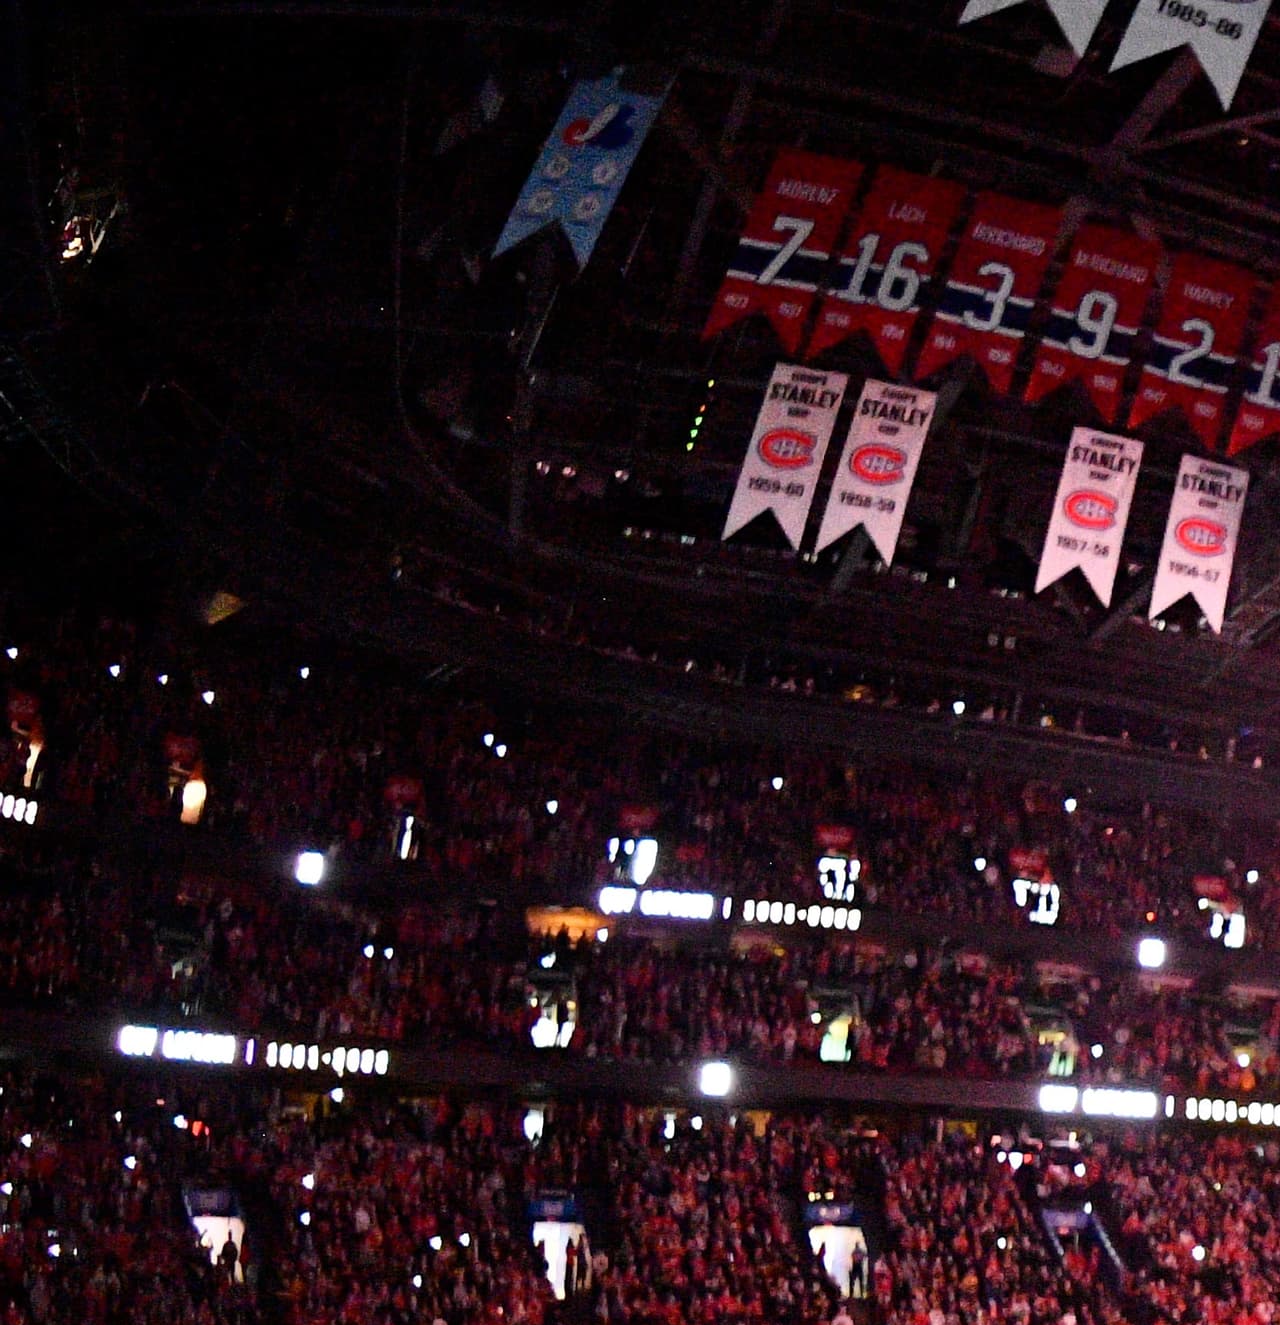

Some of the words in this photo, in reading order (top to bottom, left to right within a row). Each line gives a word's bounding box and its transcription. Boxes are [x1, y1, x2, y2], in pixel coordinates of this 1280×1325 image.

[757, 214, 816, 285] 7
[848, 232, 930, 312] 16
[963, 261, 1015, 331] 3
[1068, 289, 1119, 359] 9
[1166, 317, 1216, 389] 2
[770, 383, 841, 409] STANLEY
[861, 398, 929, 427] STANLEY
[1071, 445, 1136, 476] STANLEY
[1181, 472, 1243, 502] STANLEY
